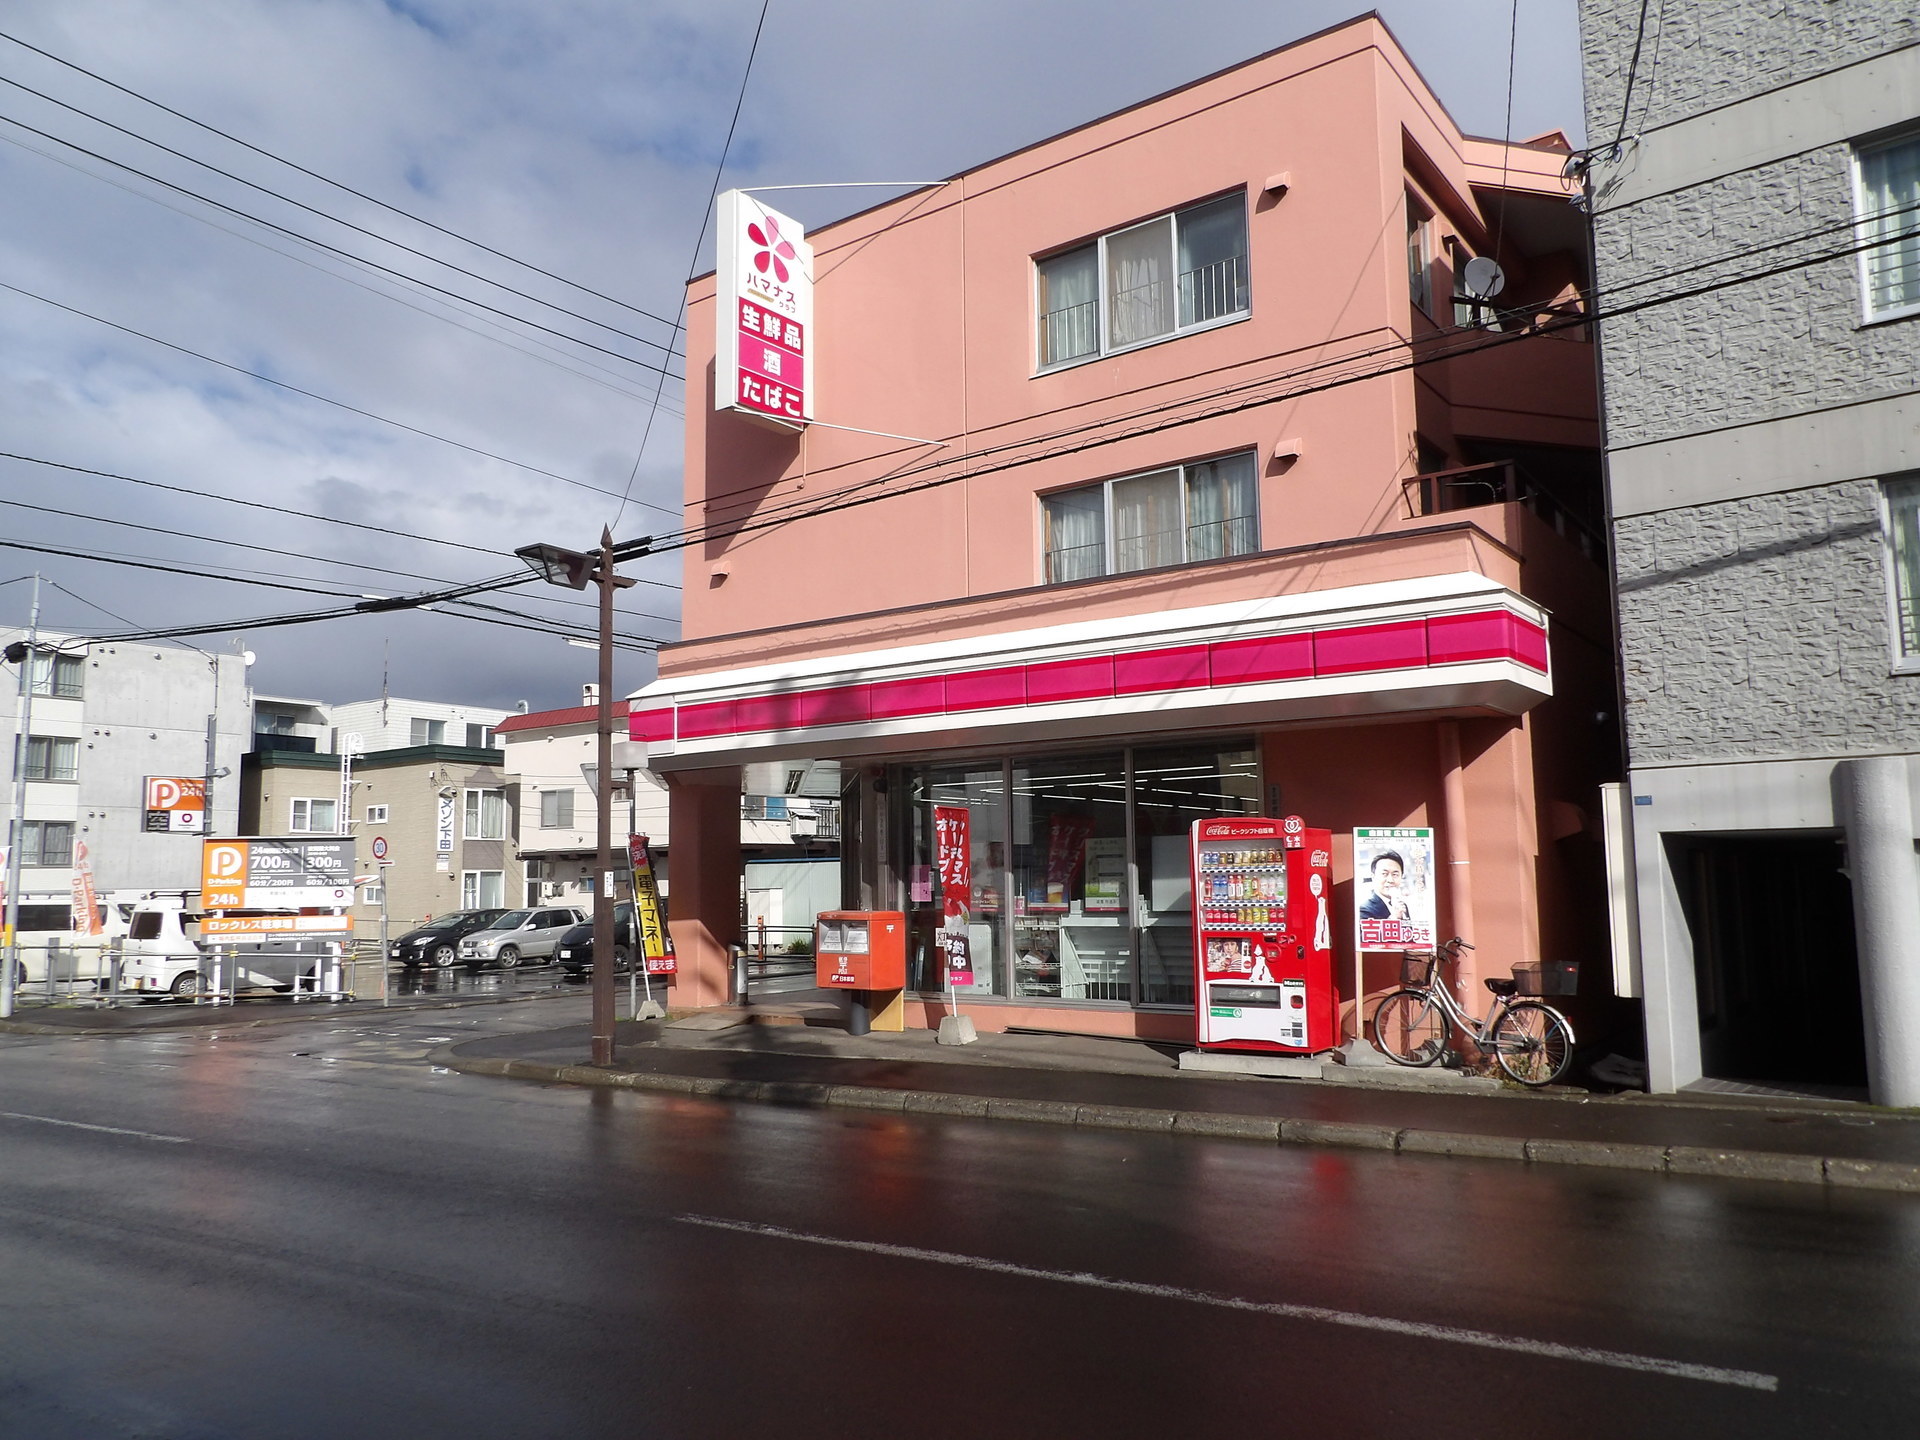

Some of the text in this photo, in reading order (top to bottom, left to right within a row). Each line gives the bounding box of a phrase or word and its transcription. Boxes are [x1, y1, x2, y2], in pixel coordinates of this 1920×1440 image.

[747, 272, 796, 305] ハマナス
[742, 304, 801, 350] 生鮮品
[763, 348, 781, 377] 酒
[742, 375, 801, 417] たばこ
[440, 799, 454, 850] メゾン下田
[376, 842, 384, 853] 30
[250, 856, 291, 869] 700円
[306, 856, 342, 869] 300円
[306, 878, 350, 886] 60分/100円
[209, 893, 239, 905] 24h
[639, 874, 659, 952] 電子マネー
[1361, 918, 1430, 942] 吉田ゆうき
